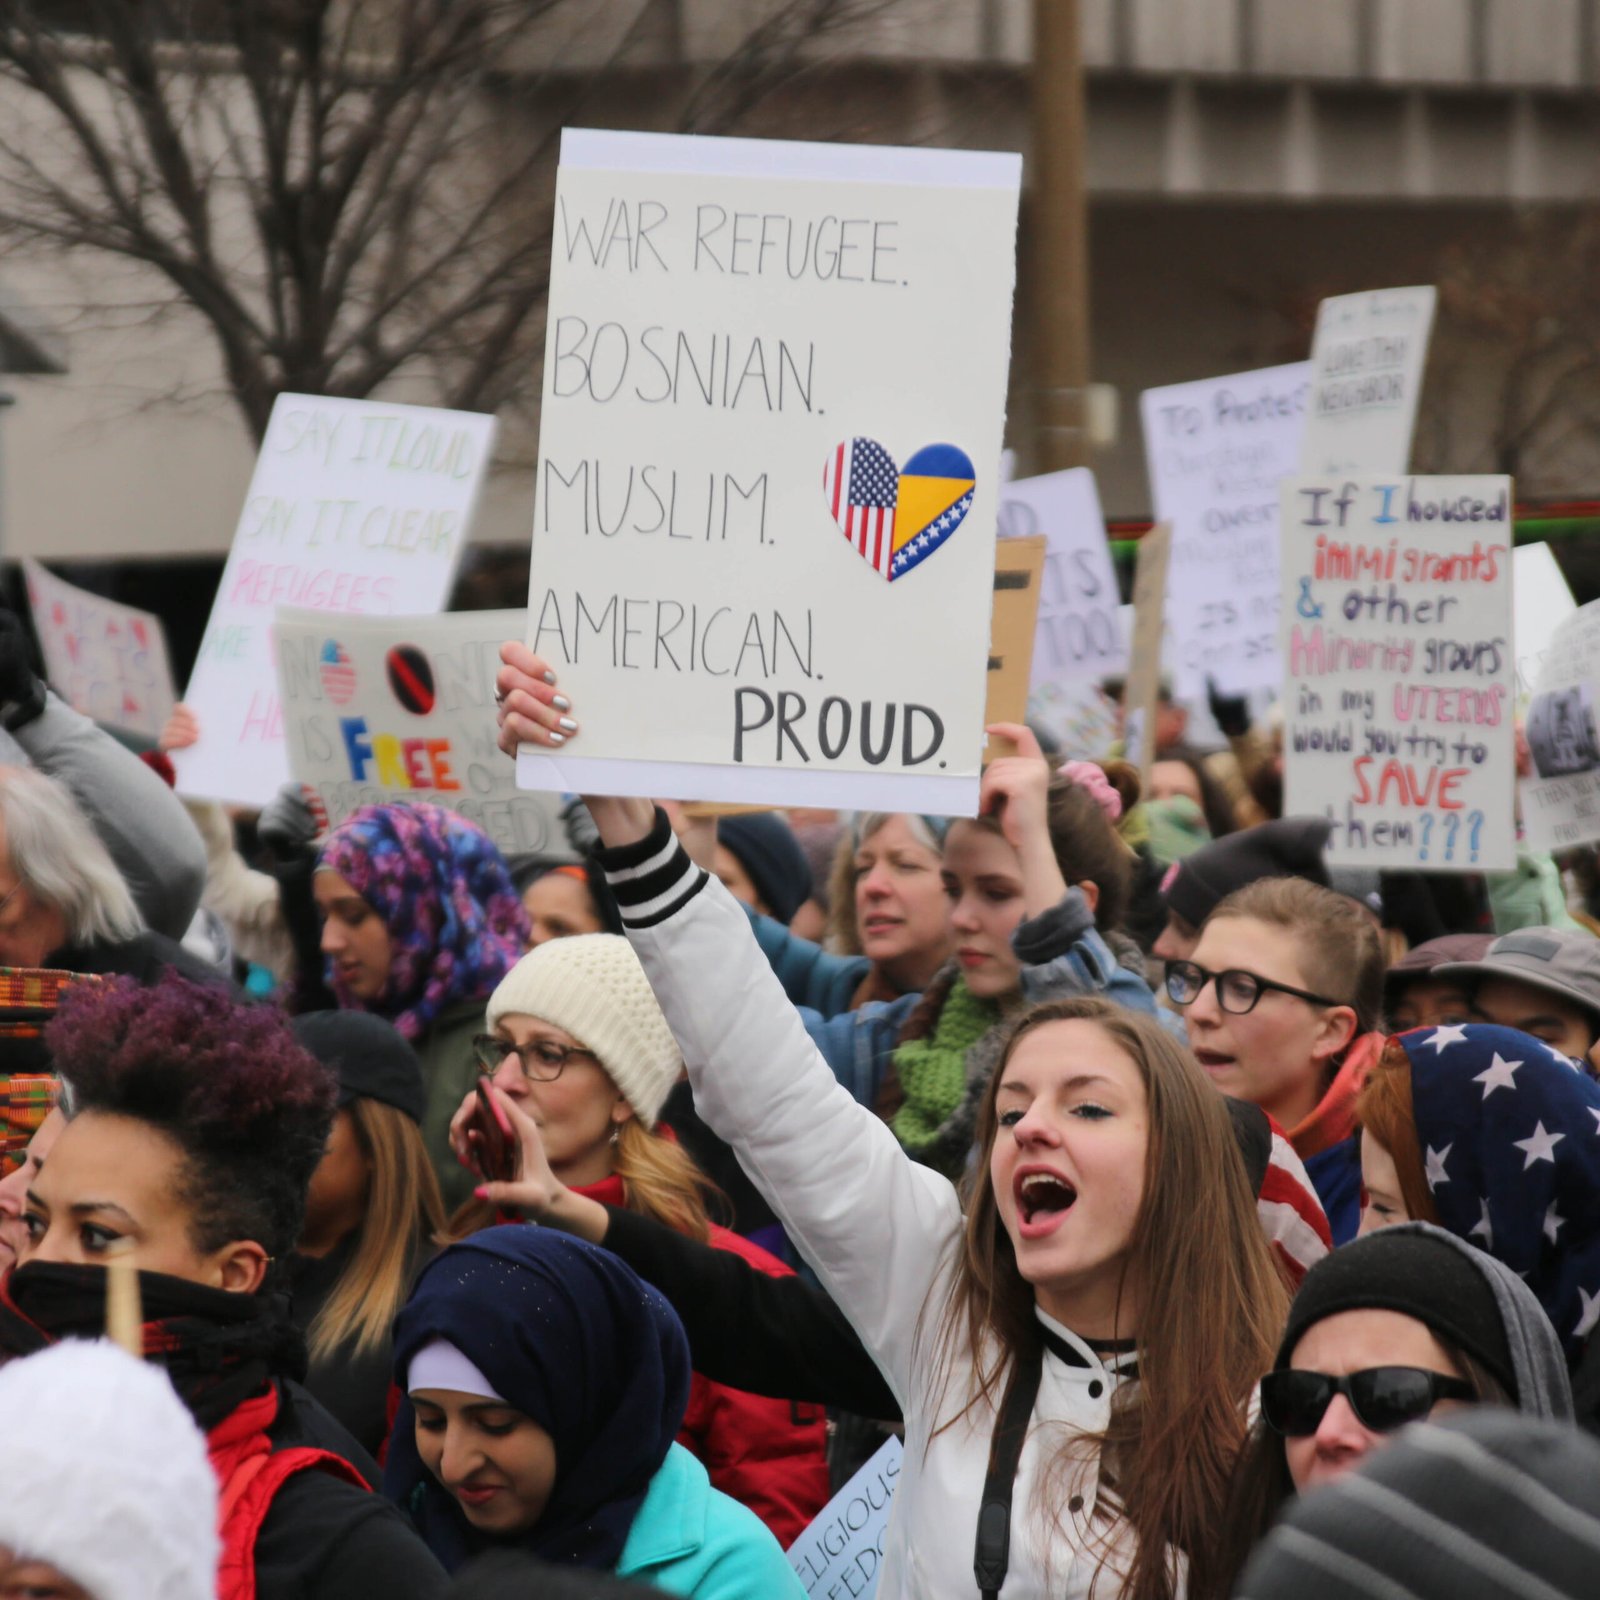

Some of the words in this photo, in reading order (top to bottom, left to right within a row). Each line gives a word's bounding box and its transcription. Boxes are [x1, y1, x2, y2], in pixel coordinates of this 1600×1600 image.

[559, 194, 669, 273] WAR
[694, 204, 909, 287] REFUGEE.
[552, 315, 826, 415] BOSNIAN.
[276, 409, 346, 467] SAY
[245, 495, 298, 546] SAY
[304, 499, 361, 549] IT
[544, 458, 776, 545] MUSLIM.
[1297, 481, 1360, 527] If
[1370, 484, 1401, 524] I
[1406, 477, 1507, 523] housed
[1295, 575, 1325, 619] &
[1342, 582, 1459, 624] other
[532, 588, 824, 681] AMERICAN.
[732, 685, 948, 769] PROUD.
[1299, 682, 1324, 715] in
[1341, 687, 1376, 721] my
[1393, 681, 1507, 727] UTERUS
[298, 715, 334, 764] IS
[338, 715, 463, 792] FREE
[1292, 718, 1354, 753] would
[1364, 725, 1401, 755] you
[1403, 724, 1446, 765] try
[1450, 731, 1489, 765] to
[1352, 754, 1472, 811] SAVE
